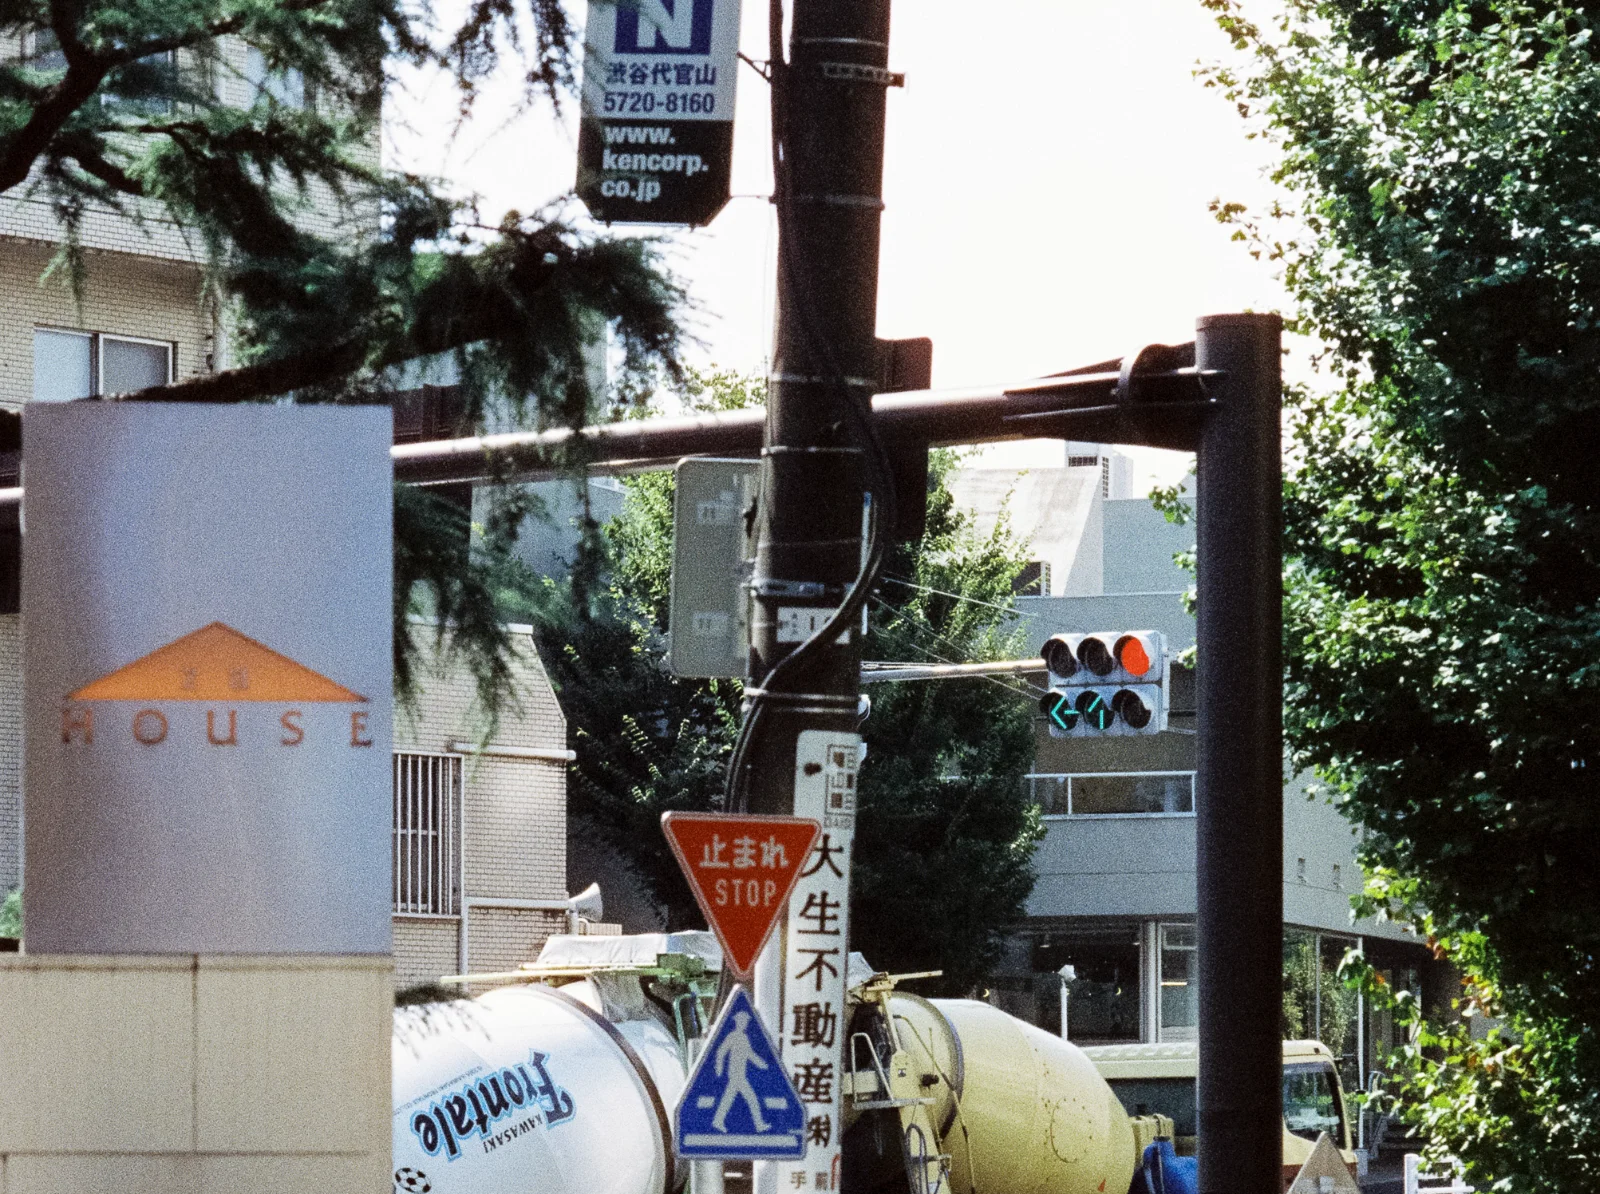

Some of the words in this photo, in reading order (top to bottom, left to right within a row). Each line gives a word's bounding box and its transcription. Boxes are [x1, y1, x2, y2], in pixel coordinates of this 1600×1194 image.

[605, 62, 716, 85] 渋谷代官山
[604, 92, 715, 113] 5720-8160
[605, 126, 676, 144] www.
[603, 149, 709, 176] kencorp.
[602, 180, 661, 201] co.jp
[62, 710, 372, 745] HOUSE
[699, 834, 789, 869] 止まれ
[715, 879, 777, 907] STOP
[410, 1049, 576, 1161] Frontale
[483, 1113, 543, 1154] KAWASAKI
